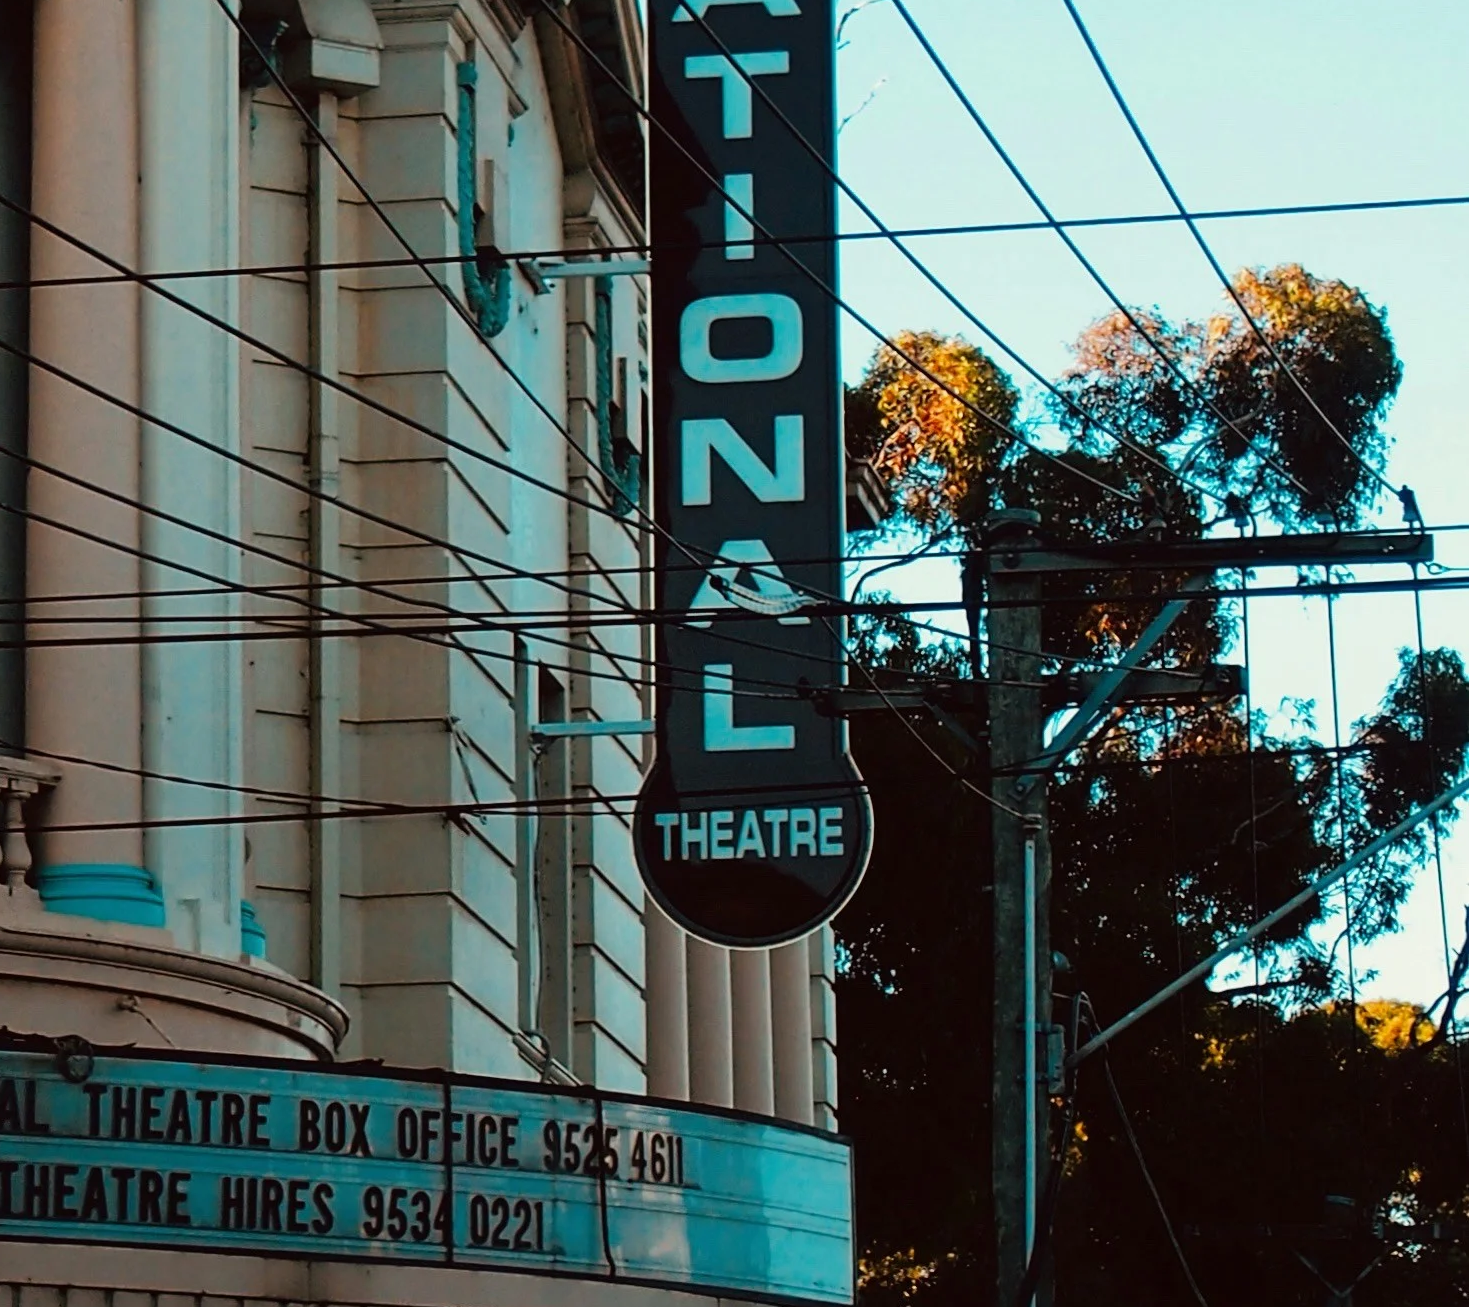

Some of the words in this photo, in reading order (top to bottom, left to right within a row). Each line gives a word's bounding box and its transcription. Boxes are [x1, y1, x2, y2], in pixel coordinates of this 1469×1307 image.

[654, 806, 845, 861] THEATRE
[82, 1083, 272, 1147] THEATRE
[299, 1100, 372, 1158] BOX
[397, 1107, 520, 1168] OFFICE
[543, 1118, 619, 1179] 9525
[631, 1130, 685, 1185] 4611
[221, 1176, 334, 1234] HIRES
[362, 1186, 449, 1245] 9534
[471, 1194, 544, 1251] 0221
